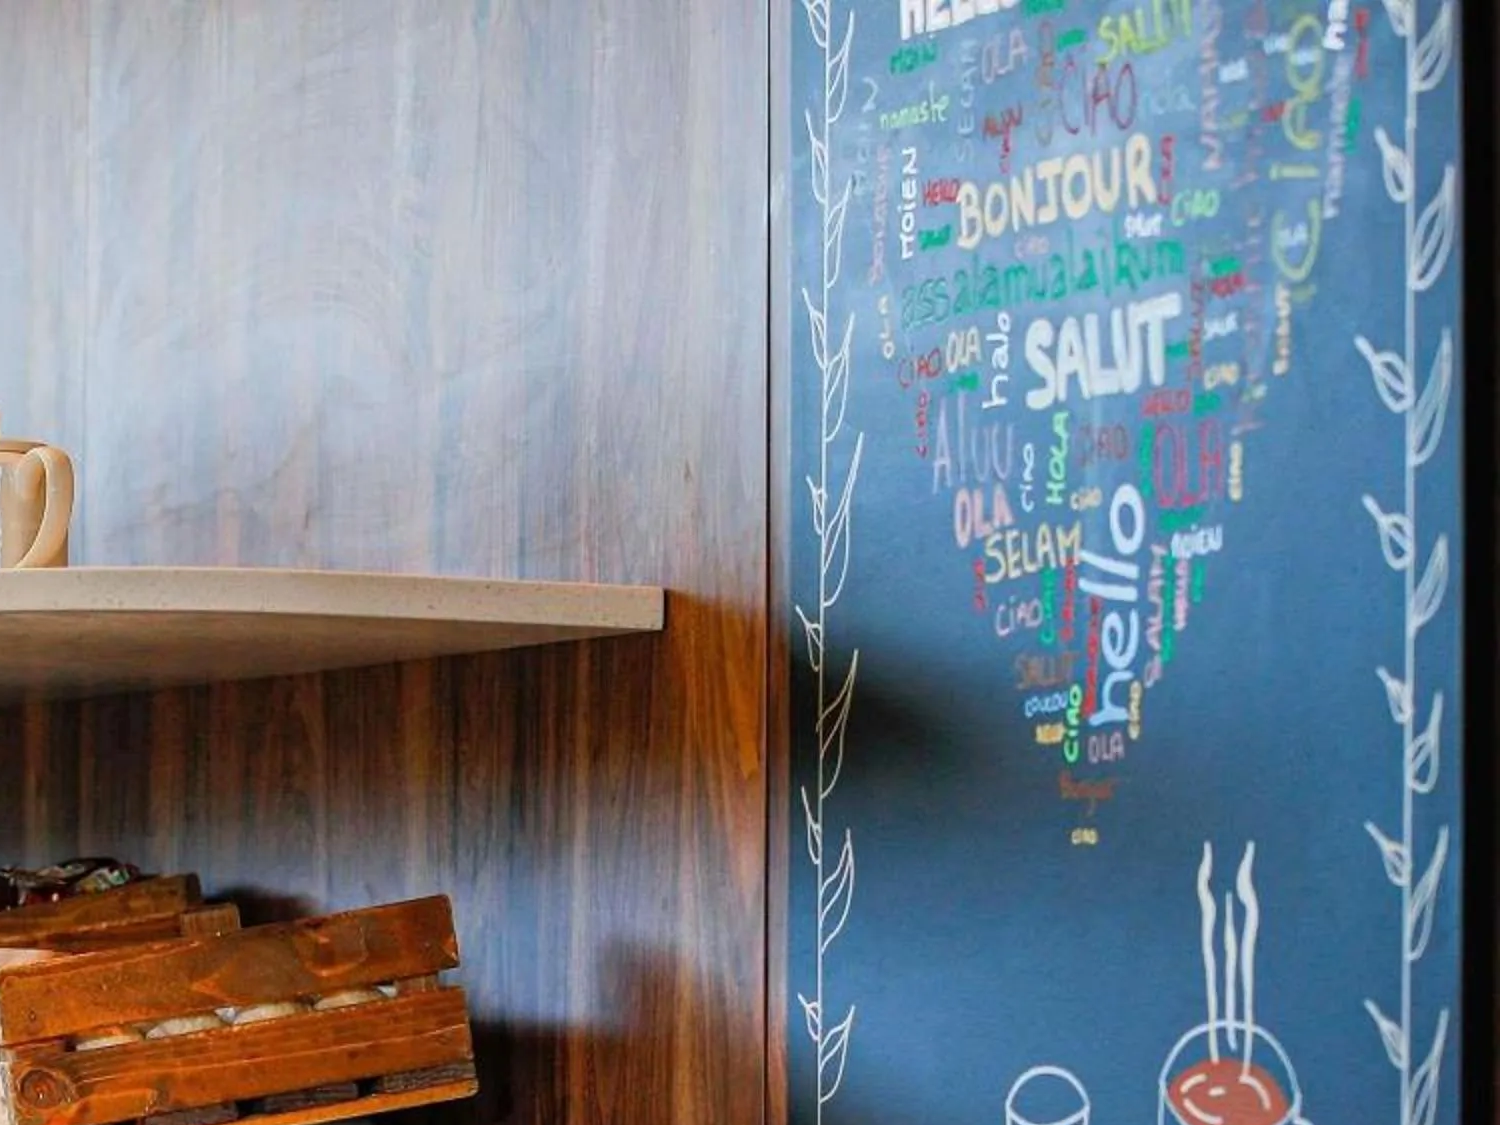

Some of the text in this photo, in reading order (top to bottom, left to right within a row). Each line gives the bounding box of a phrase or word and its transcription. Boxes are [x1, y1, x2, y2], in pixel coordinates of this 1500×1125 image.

[956, 133, 1157, 250] BONJOUR
[1025, 291, 1182, 410] SALUT
[1153, 420, 1225, 507] OLA
[953, 486, 1015, 548] OLA
[984, 522, 1082, 583] SELAM
[1077, 484, 1147, 726] hello
